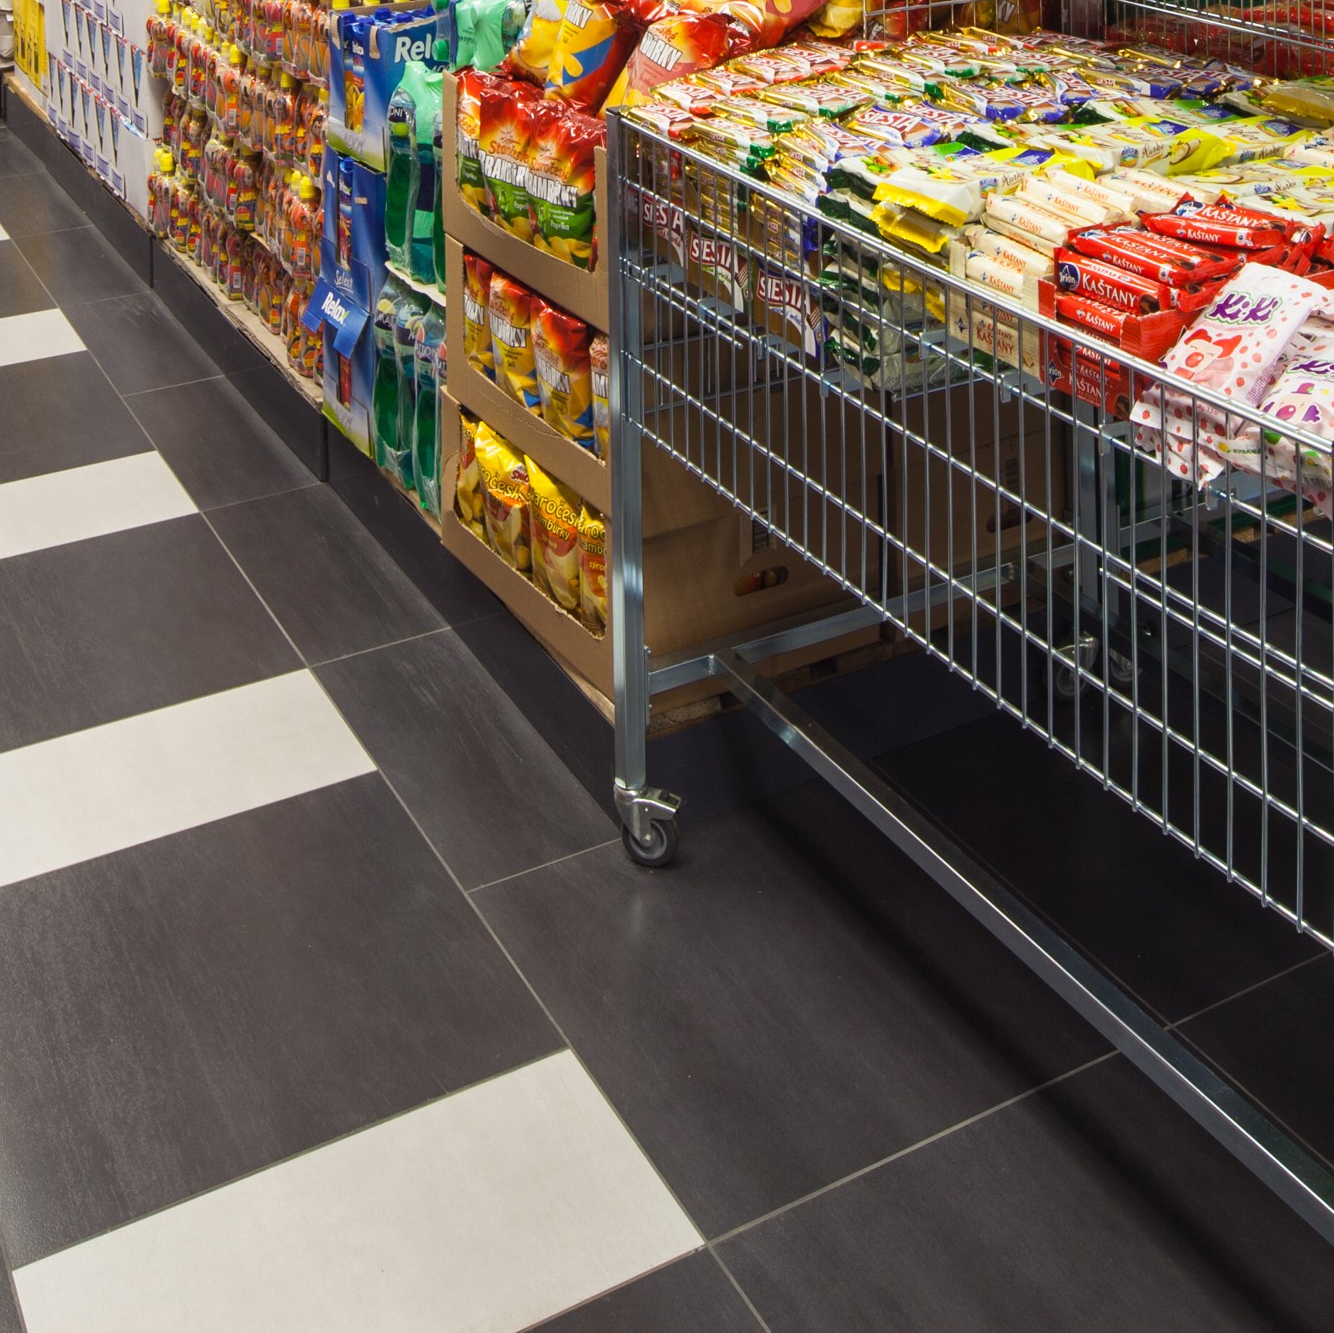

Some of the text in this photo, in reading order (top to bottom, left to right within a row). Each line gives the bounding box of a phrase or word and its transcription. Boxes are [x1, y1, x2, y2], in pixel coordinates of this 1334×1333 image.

[650, 104, 689, 122] SIESTA
[860, 110, 922, 132] SIESTA
[907, 103, 958, 126] SIESTA
[1201, 204, 1266, 229] KAŠTANY
[1187, 228, 1219, 242] KAŠTANY
[1112, 254, 1144, 274] KAŠTANY
[1082, 268, 1137, 306] KAŠTANY
[322, 292, 346, 324] Relax
